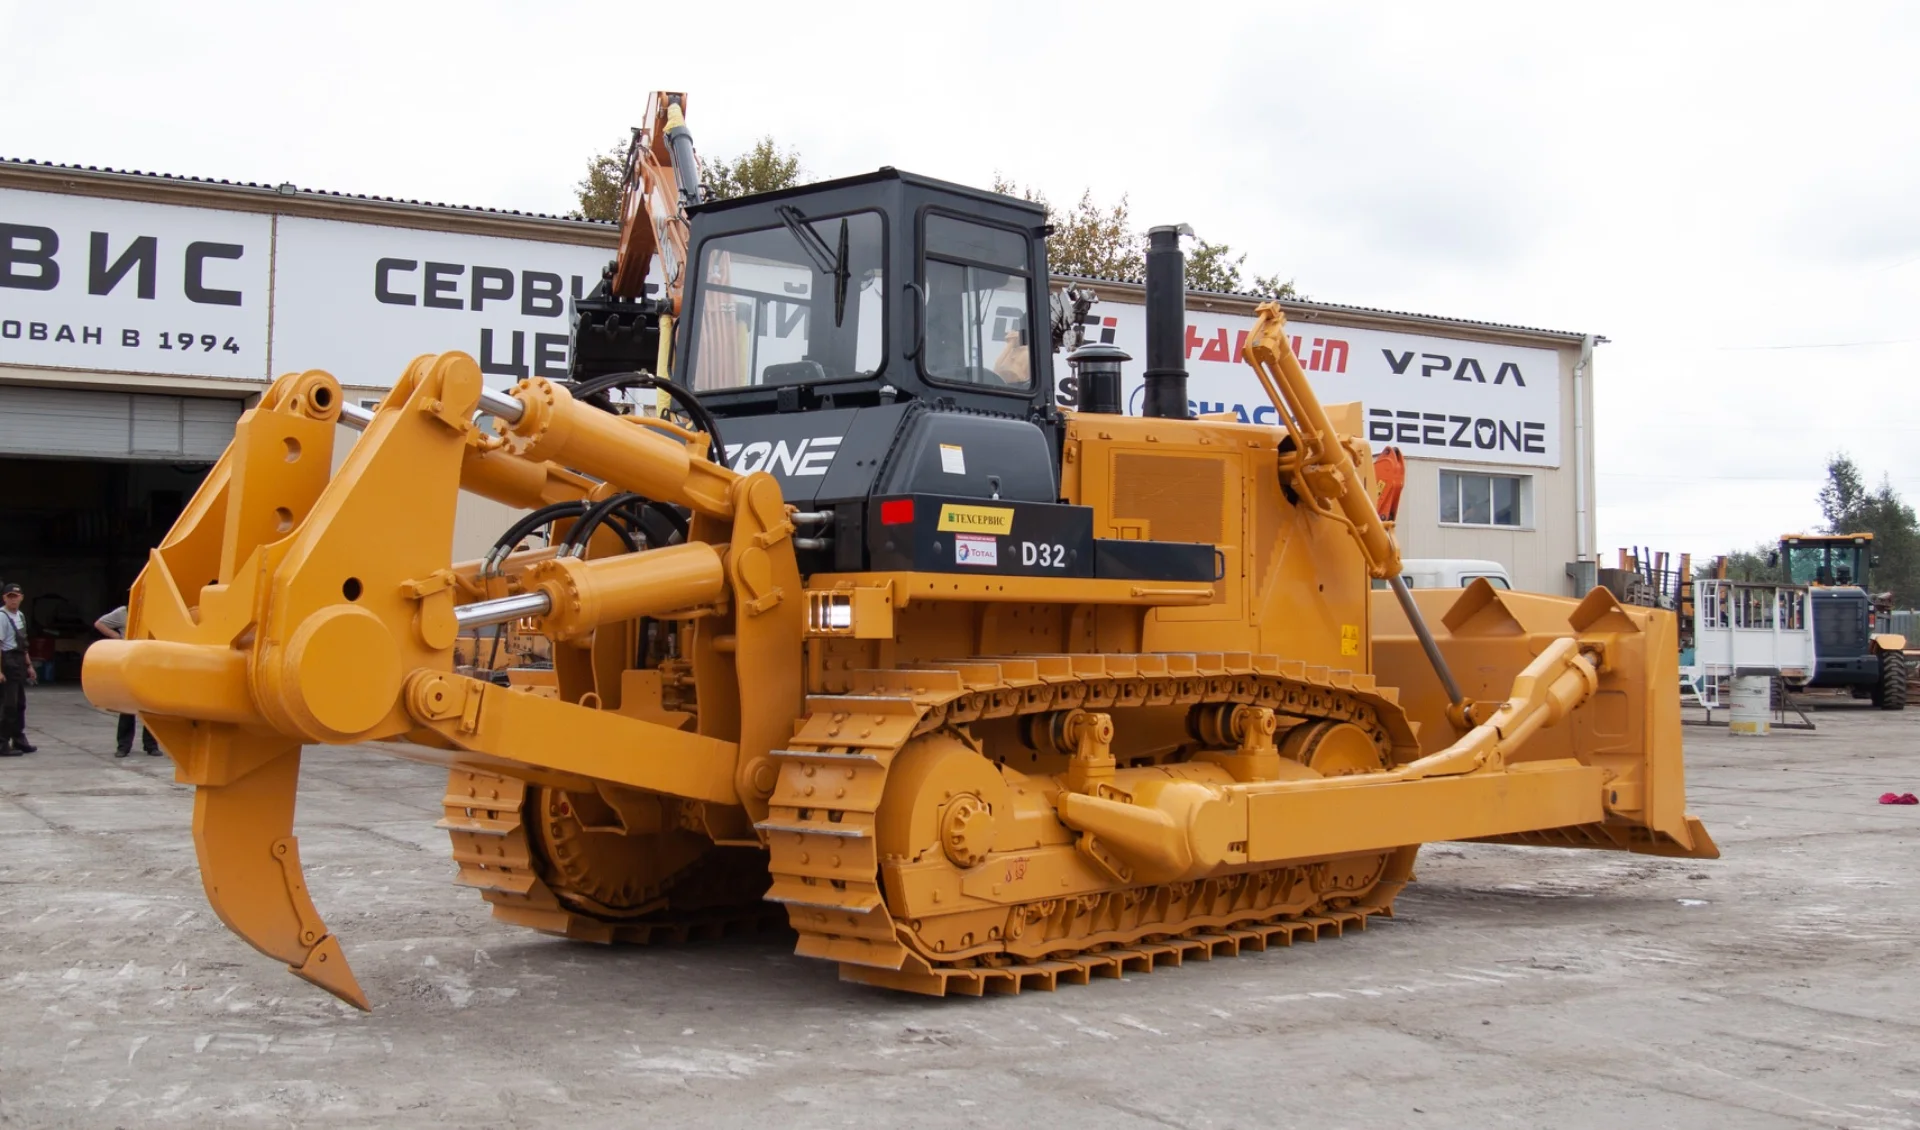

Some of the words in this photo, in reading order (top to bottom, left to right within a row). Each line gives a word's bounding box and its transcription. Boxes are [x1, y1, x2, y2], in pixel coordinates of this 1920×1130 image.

[121, 329, 140, 347] В
[159, 331, 240, 354] 1994
[480, 328, 569, 384] ЦЕ
[1369, 408, 1546, 454] BEEZONE
[955, 513, 1006, 526] ТЕХСЕРВИС
[1022, 541, 1066, 568] D32
